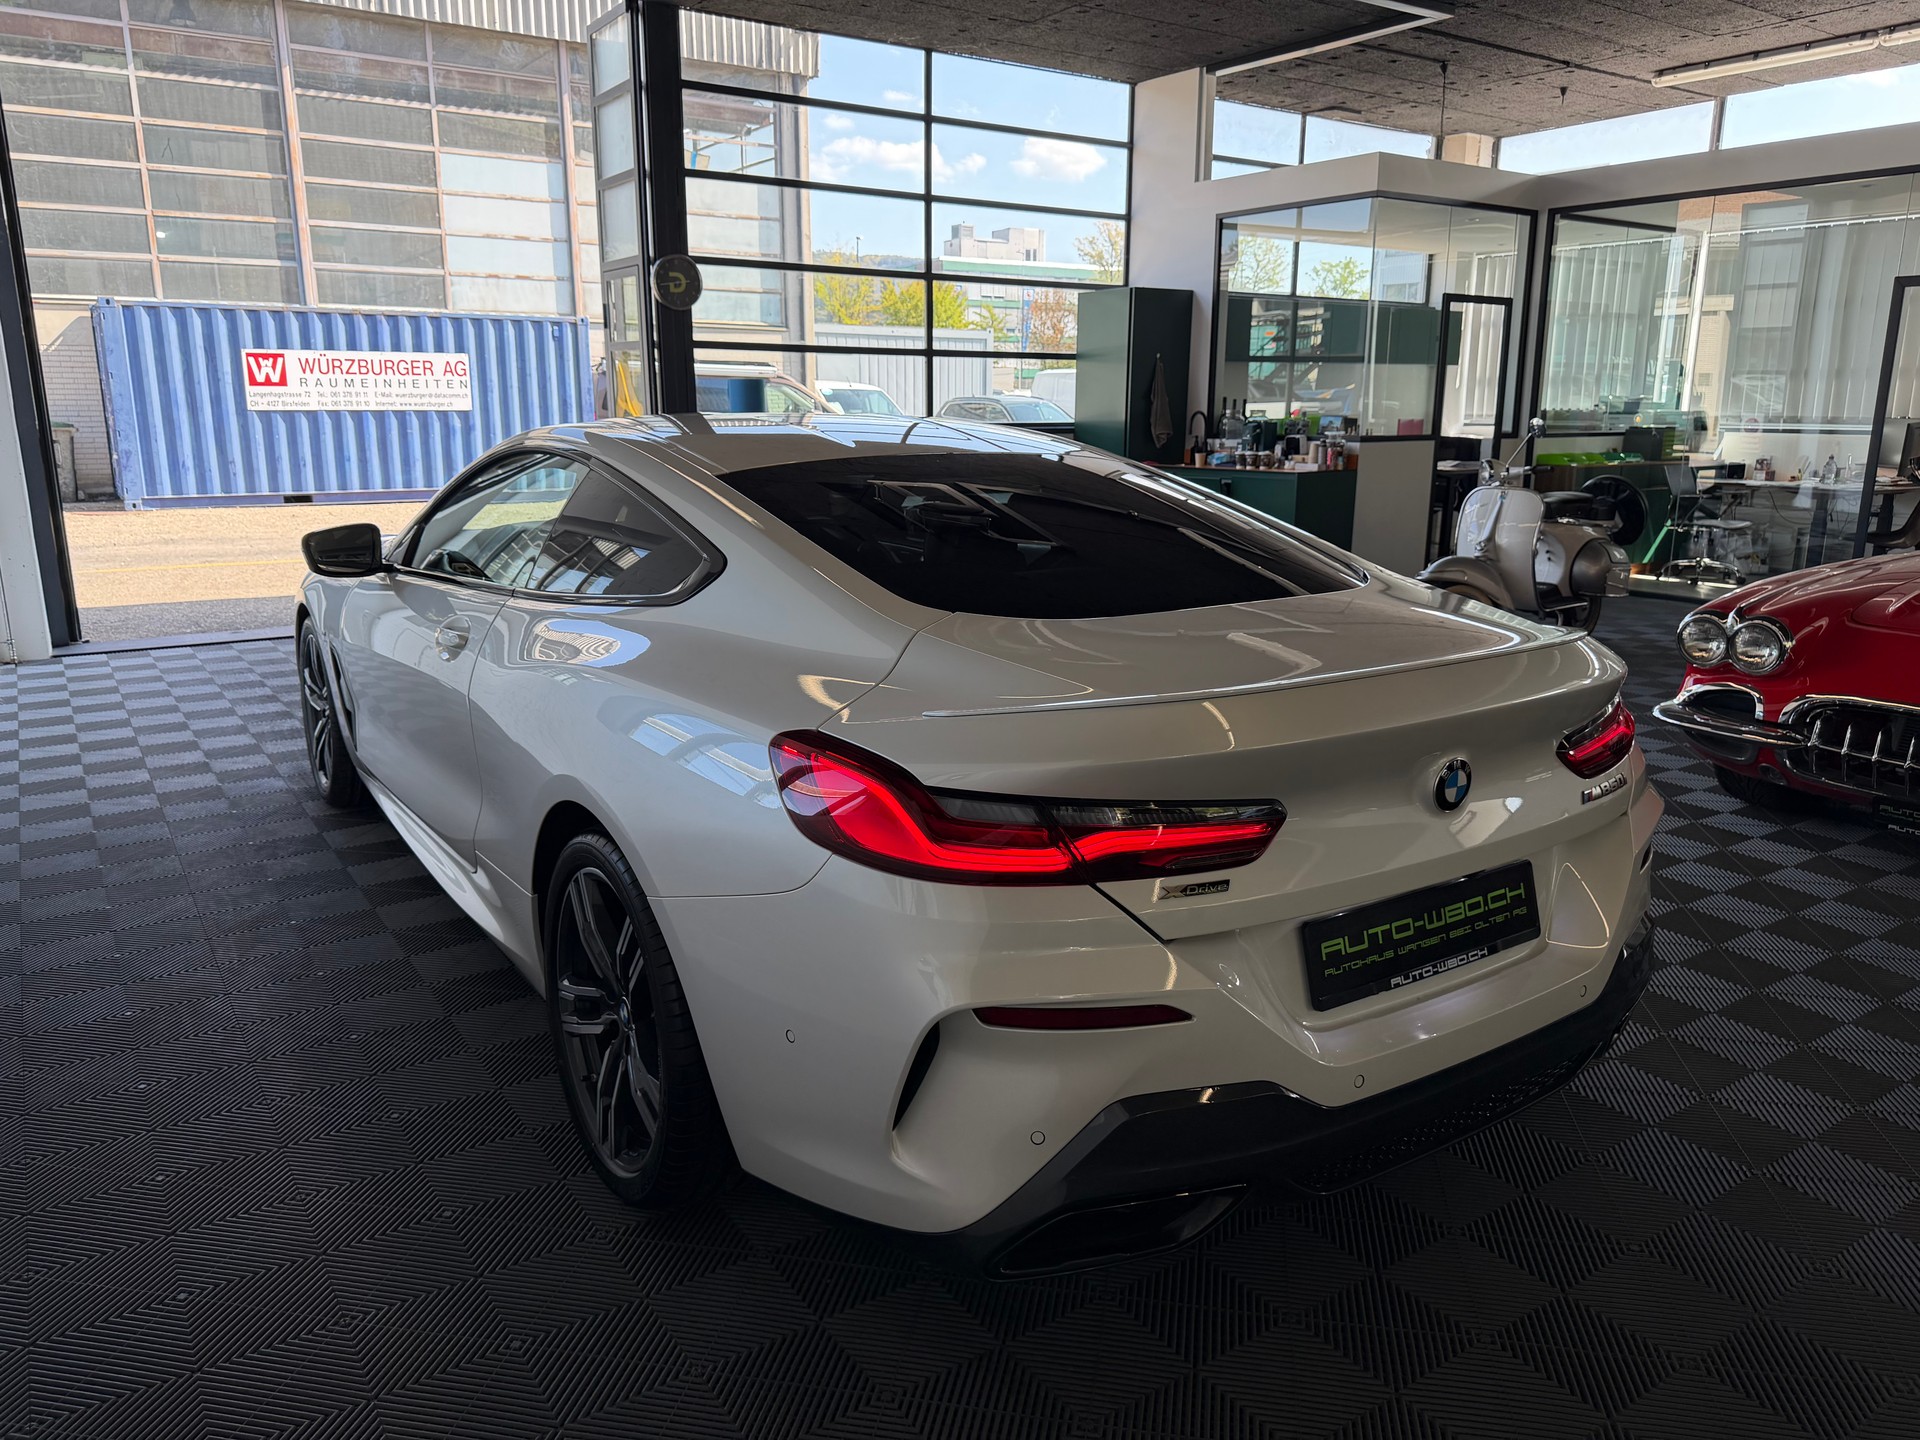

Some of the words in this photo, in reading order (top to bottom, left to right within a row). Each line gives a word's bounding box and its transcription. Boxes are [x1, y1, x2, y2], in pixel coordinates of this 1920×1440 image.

[297, 353, 434, 377] WÜRZBURGER
[443, 360, 467, 377] AG
[249, 391, 302, 399] Langenhagstrasse
[299, 378, 468, 389] RAUMEINHEITEN
[1321, 882, 1526, 961] AUTO-WBO.CH
[1324, 949, 1395, 978] AUTOHAUS
[1397, 933, 1447, 955] WANGEN
[1449, 925, 1473, 939] BEI
[1474, 912, 1511, 930] OLTEN
[1513, 906, 1527, 917] AG
[1390, 946, 1488, 988] AUTO-WBO.CH
